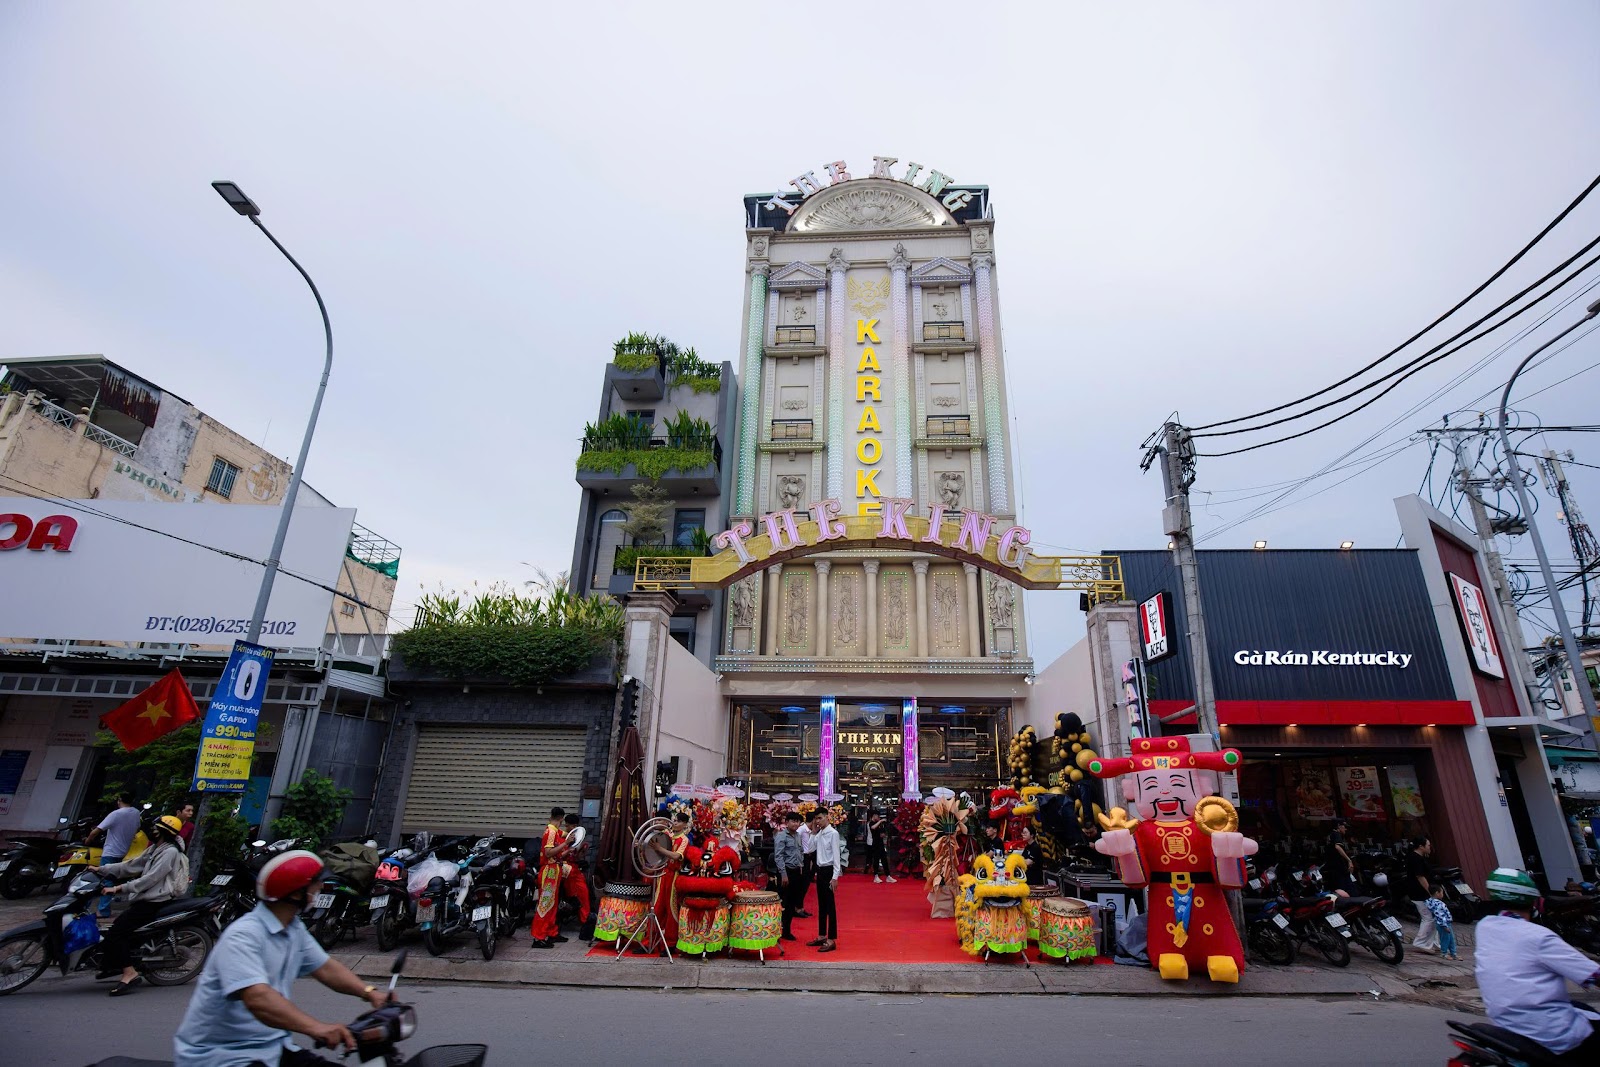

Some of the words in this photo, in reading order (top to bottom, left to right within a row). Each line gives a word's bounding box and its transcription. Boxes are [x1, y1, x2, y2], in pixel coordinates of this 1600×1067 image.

[764, 159, 850, 216] THE
[869, 155, 973, 213] KING
[715, 498, 847, 568] THE
[877, 496, 1033, 571] KING
[1150, 639, 1165, 657] KFC
[1233, 650, 1264, 666] Gà
[1264, 650, 1308, 666] Rán
[1311, 650, 1412, 669] Kentucky
[212, 701, 228, 712] Máy
[215, 724, 239, 737] 990
[853, 746, 894, 754] KARAOKE
